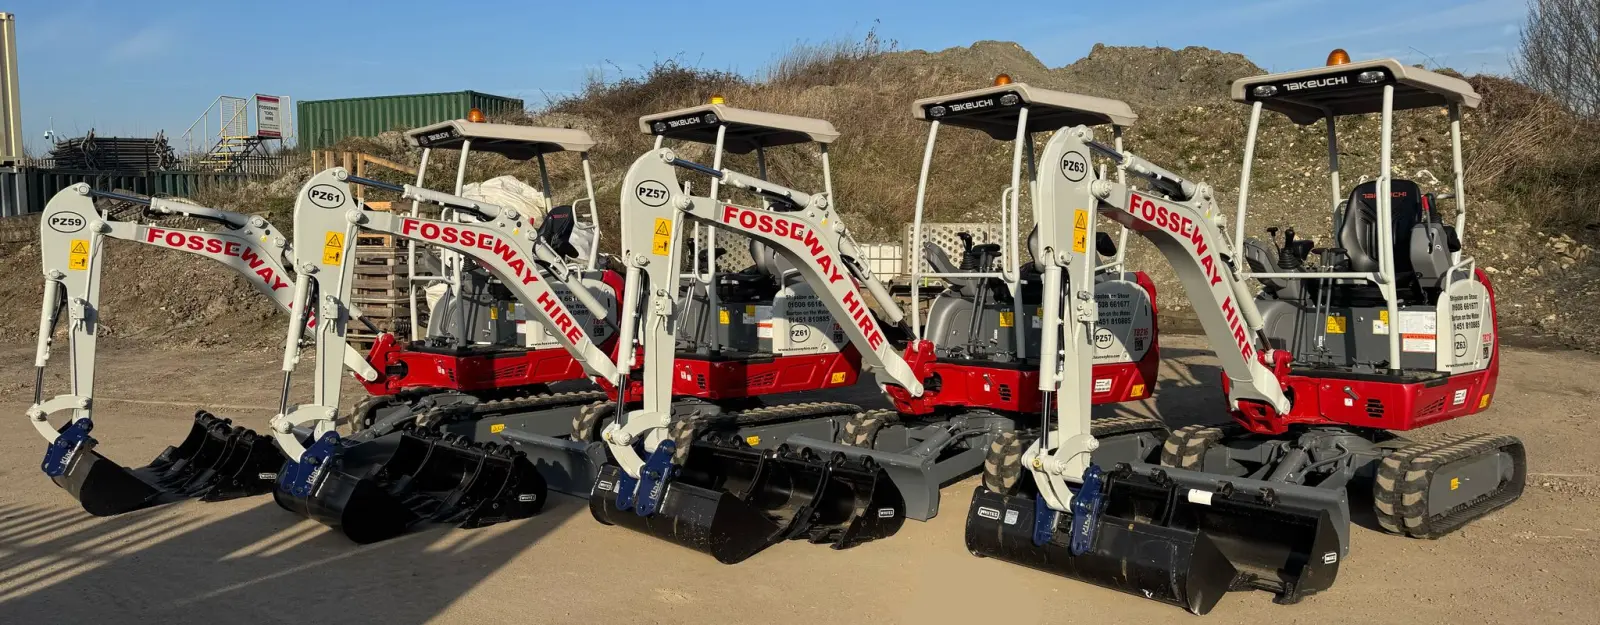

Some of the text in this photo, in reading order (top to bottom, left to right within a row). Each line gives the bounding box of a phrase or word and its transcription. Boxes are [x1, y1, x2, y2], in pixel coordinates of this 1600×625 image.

[1283, 76, 1348, 90] TAKEUCHI
[949, 99, 993, 112] TAKEUCHI
[668, 117, 700, 128] TAKEUCHI
[1064, 160, 1084, 173] PZ63
[312, 190, 339, 202] PZ61
[639, 187, 666, 199] PZ57
[52, 218, 82, 226] PZ59
[147, 227, 288, 291] FOSSEWAY
[402, 218, 583, 346] FOSSEWAY HIRE
[723, 205, 883, 351] FOSSEWAY HIRE
[1129, 193, 1252, 363] FOSSEWAY HIRE
[649, 480, 661, 500] Klac
